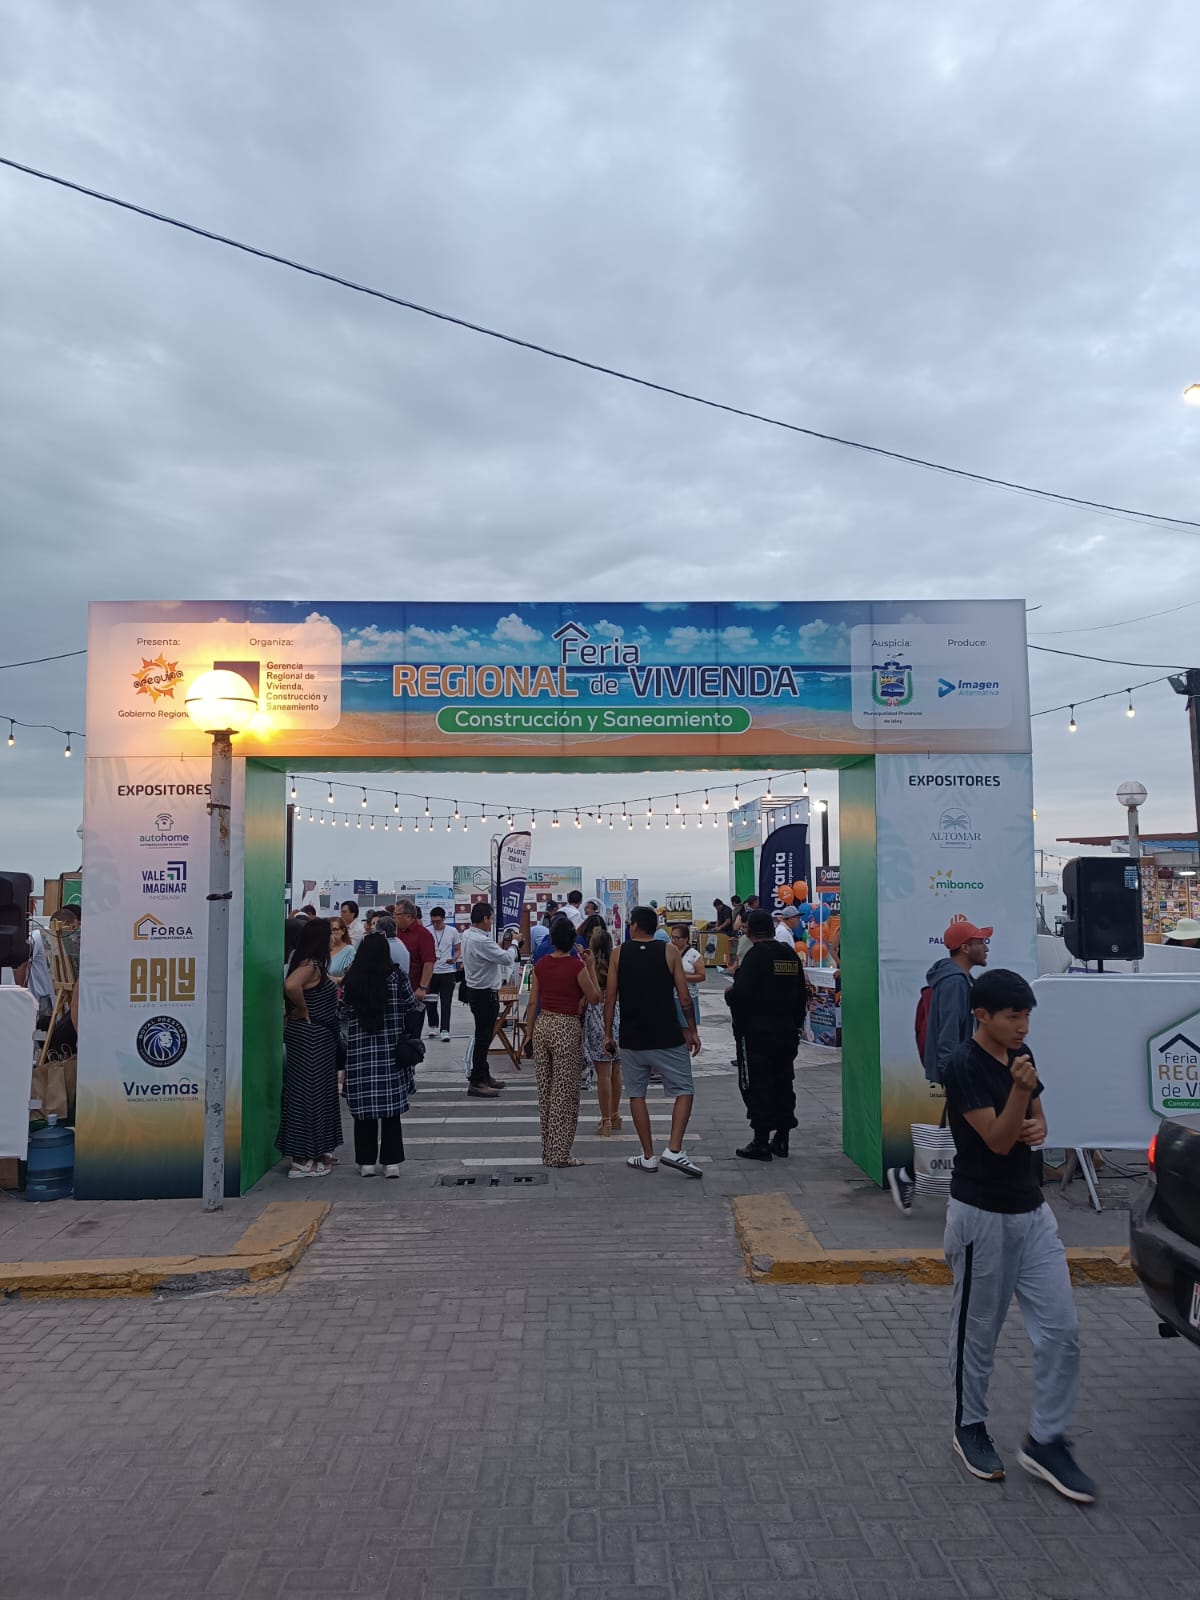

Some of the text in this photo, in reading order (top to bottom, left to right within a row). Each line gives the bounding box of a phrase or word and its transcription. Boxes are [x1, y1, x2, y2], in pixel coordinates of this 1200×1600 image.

[136, 637, 181, 647] Presenta:
[249, 638, 294, 648] Organiza:
[871, 639, 913, 649] Auspicia:
[947, 639, 988, 647] Produce:
[561, 638, 640, 664] Feria
[266, 661, 304, 670] Gerencia
[266, 672, 315, 682] Regional de
[393, 666, 800, 698] REGIONAL de VIVIENDA
[266, 682, 304, 692] Vivienda,
[958, 680, 999, 690] Imagen
[266, 692, 328, 703] Construcción y
[958, 689, 1000, 697] Alternativa
[266, 703, 319, 712] Saneamiento
[118, 710, 156, 719] Gobierno
[455, 709, 733, 731] Construcción y Saneamiento
[908, 775, 1001, 787] EXPOSITORES
[117, 784, 212, 797] EXPOSITORES
[139, 833, 190, 842] autohome
[929, 832, 982, 841] ALTOMAR
[142, 870, 166, 881] VALE
[142, 883, 187, 894] IMAGINAR
[936, 879, 985, 890] mibanco
[151, 926, 193, 936] FORGA
[130, 957, 196, 1002] ARLY
[138, 1017, 186, 1039] ROYAL PRESTIGE
[1165, 1052, 1198, 1064] Feria
[1161, 1083, 1181, 1098] de
